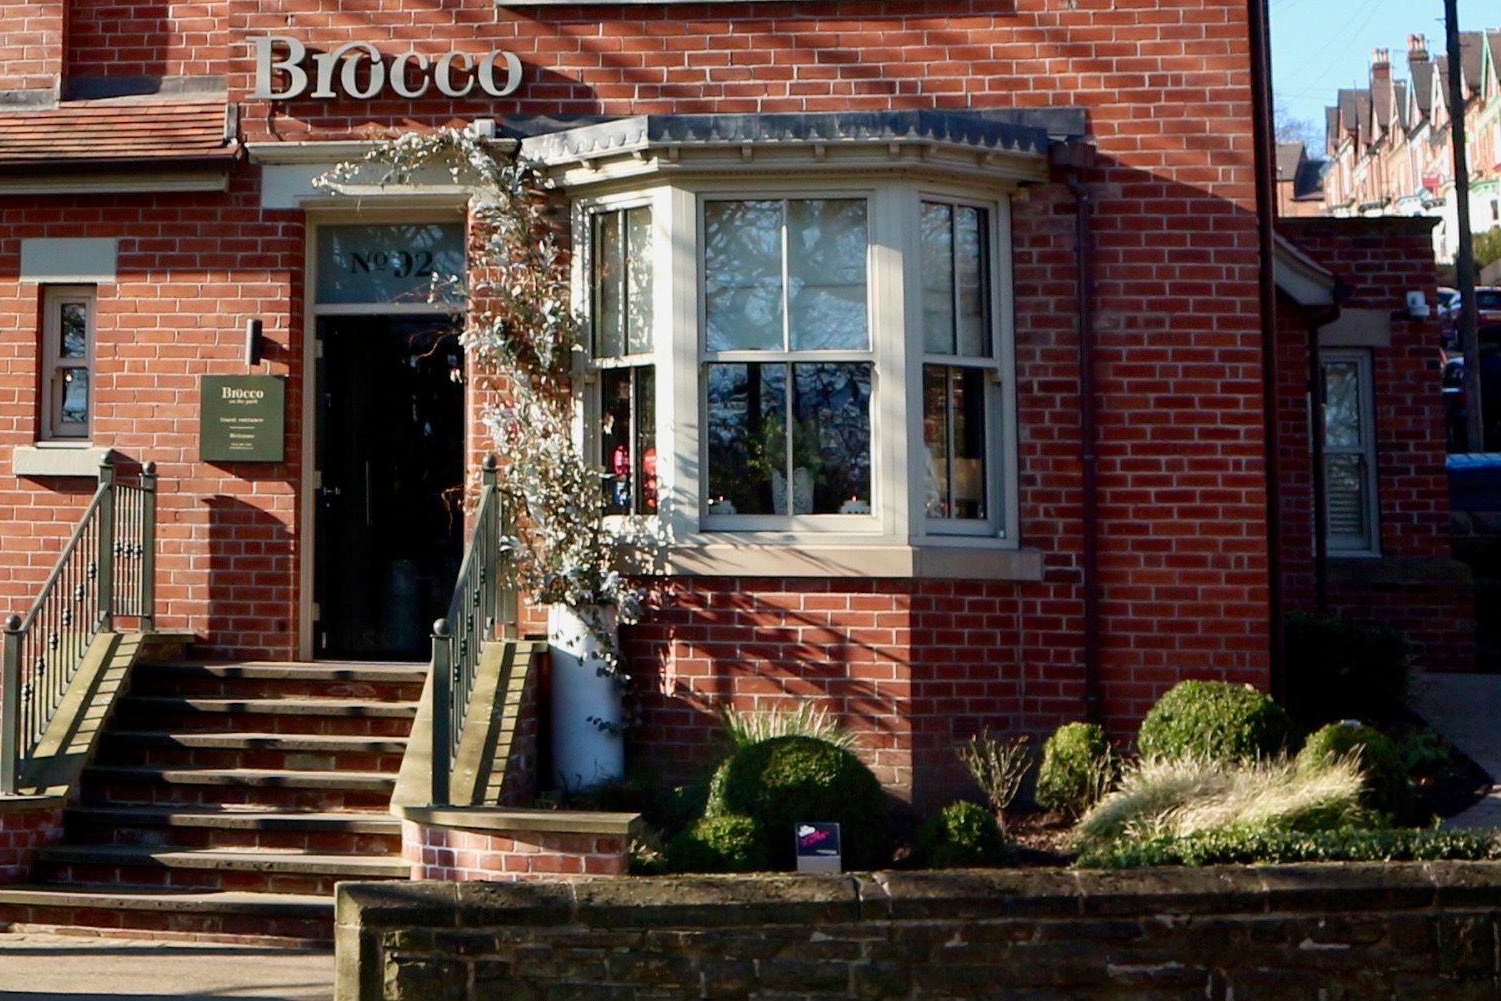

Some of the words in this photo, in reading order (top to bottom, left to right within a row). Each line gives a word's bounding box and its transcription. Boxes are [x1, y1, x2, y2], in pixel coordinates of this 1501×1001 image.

[245, 35, 523, 100] Brocco
[393, 250, 435, 277] 92
[221, 386, 265, 399] Brocco
